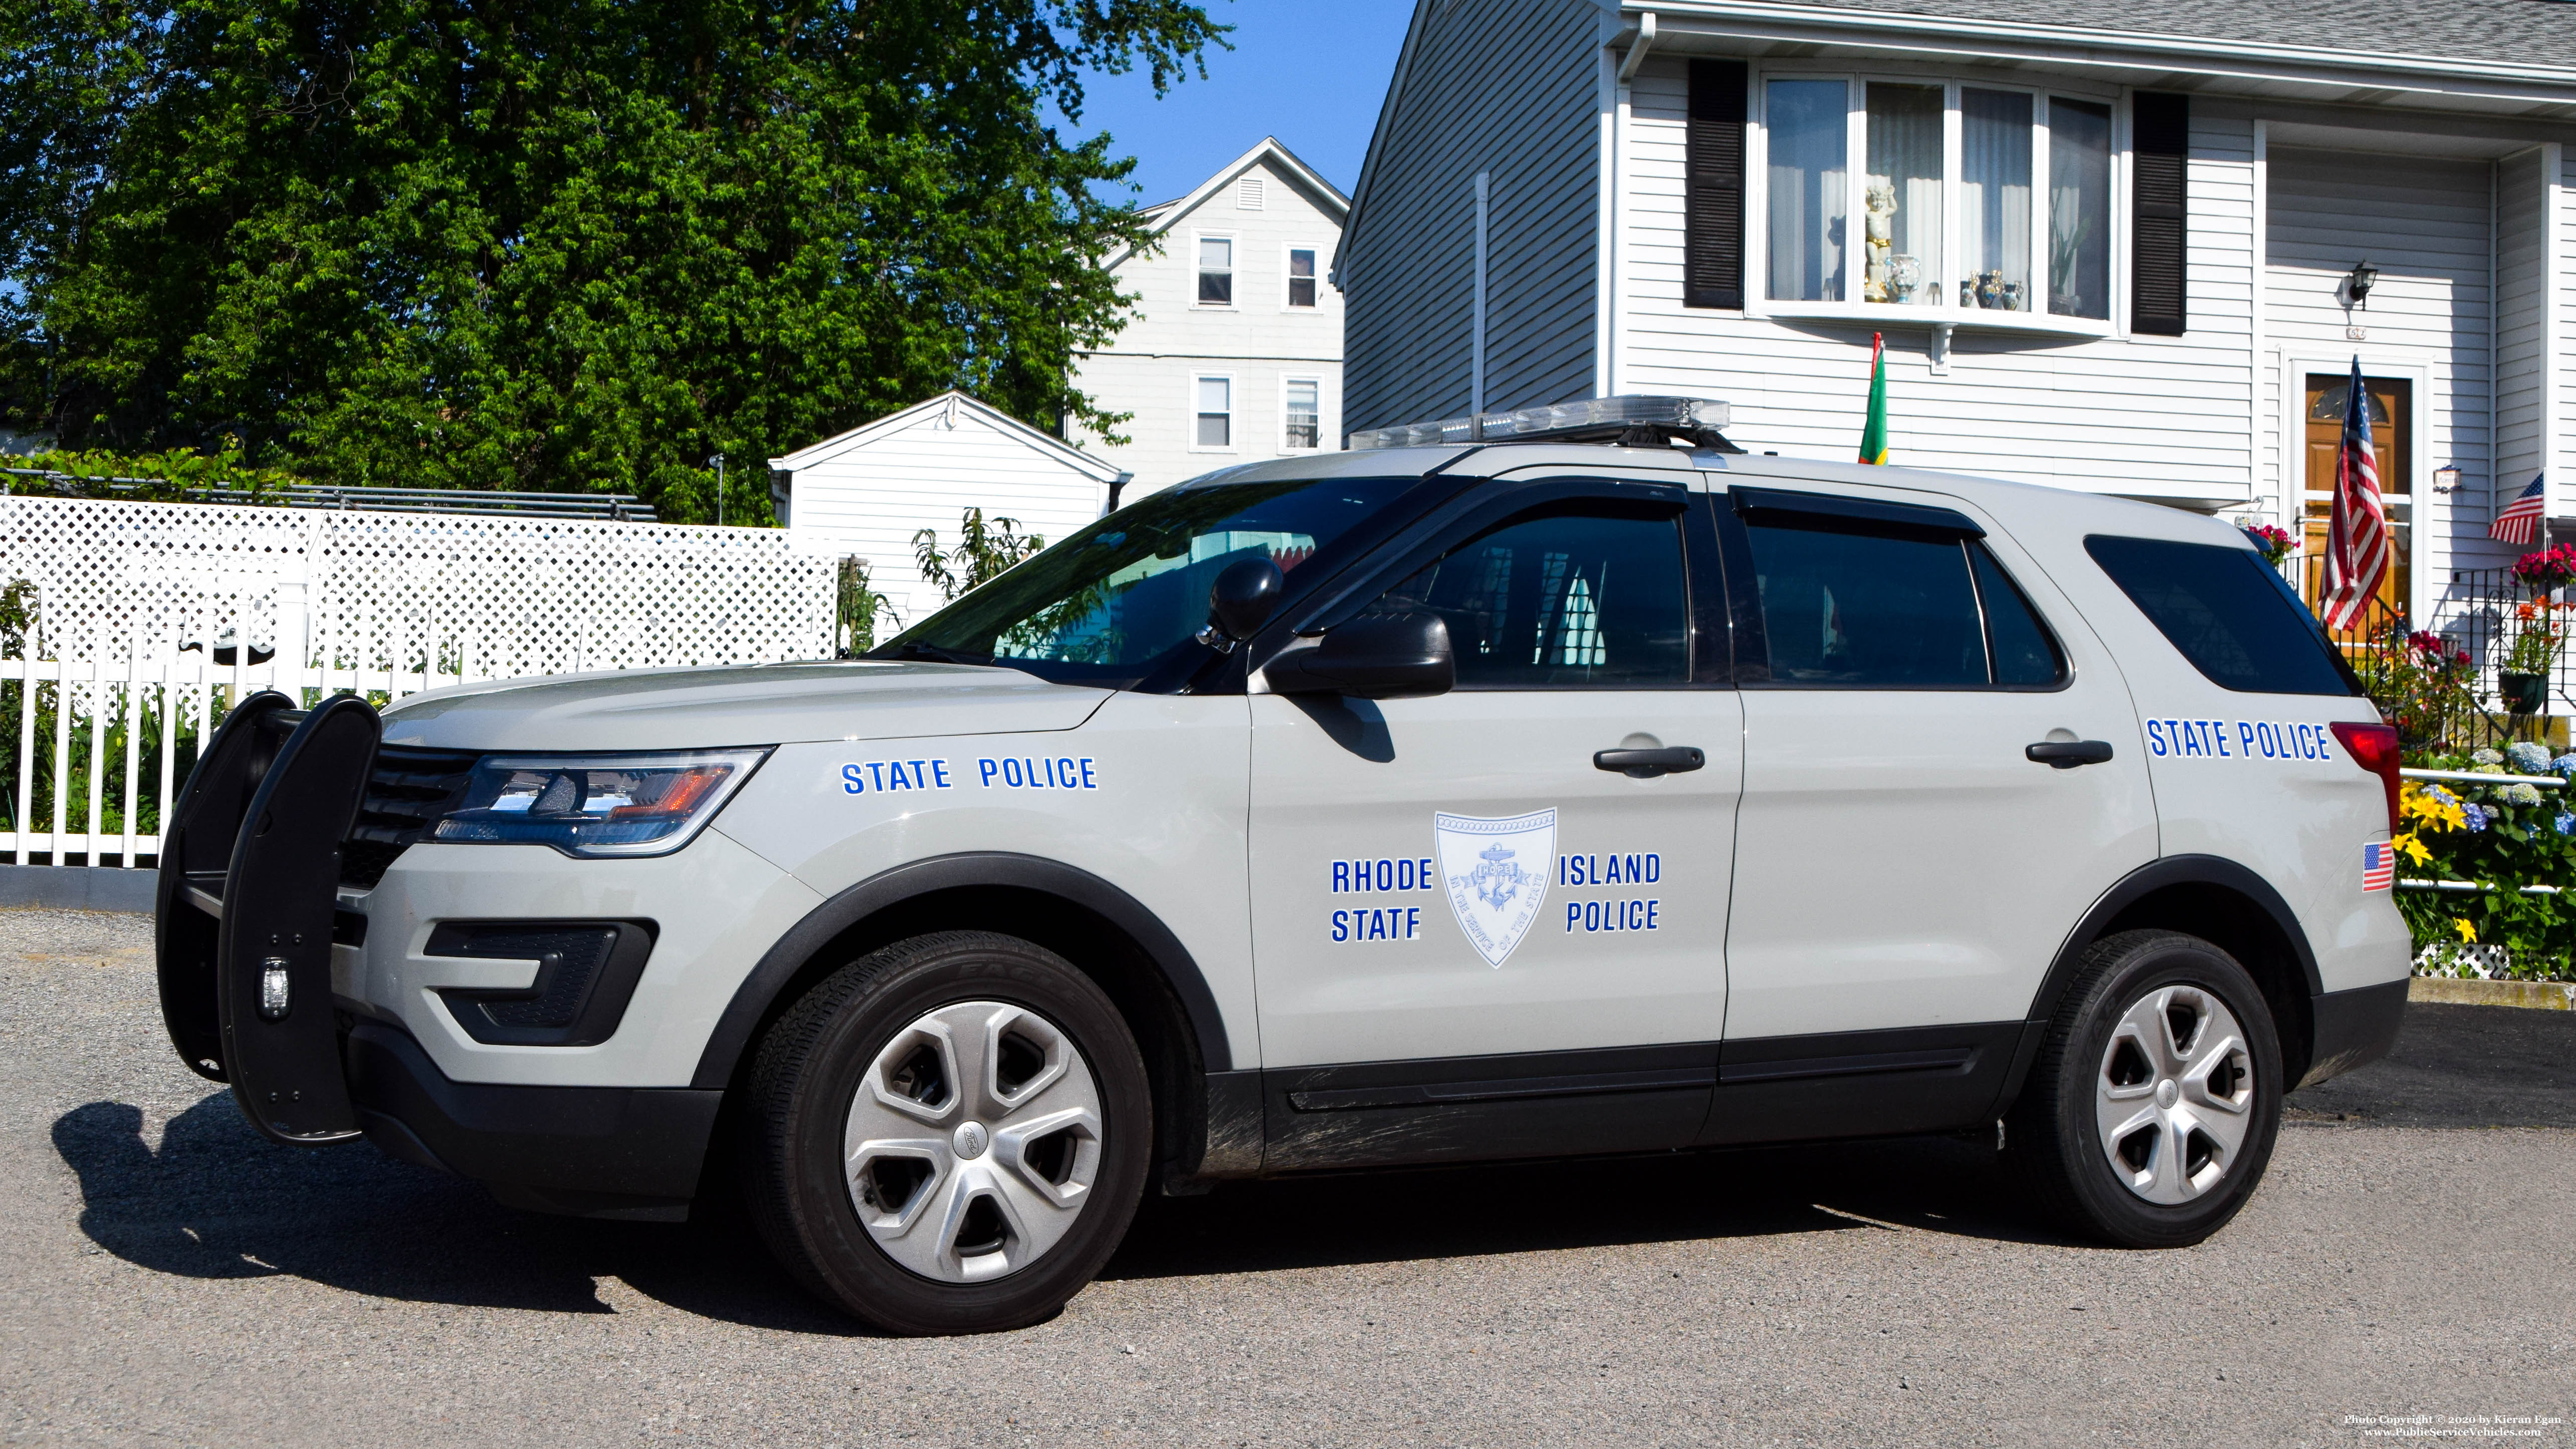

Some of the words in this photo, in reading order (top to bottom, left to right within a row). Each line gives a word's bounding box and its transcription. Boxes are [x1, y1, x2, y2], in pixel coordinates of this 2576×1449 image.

[2146, 719, 2231, 757] STATE
[2237, 721, 2330, 760] POLICE
[841, 759, 951, 795] STATE
[977, 757, 1097, 789] POLICE
[1332, 858, 1432, 893] RHODE
[1560, 853, 1660, 886] ISLAND
[1483, 865, 1510, 874] HOPE
[1450, 875, 1460, 889] IN
[1455, 890, 1469, 913] THE
[1465, 913, 1494, 952] SERVICE
[1499, 934, 1511, 950] OF
[1511, 911, 1529, 933] THE
[1526, 873, 1544, 909] STATE
[1567, 899, 1659, 932] POLICE
[965, 1130, 978, 1152] Ford
